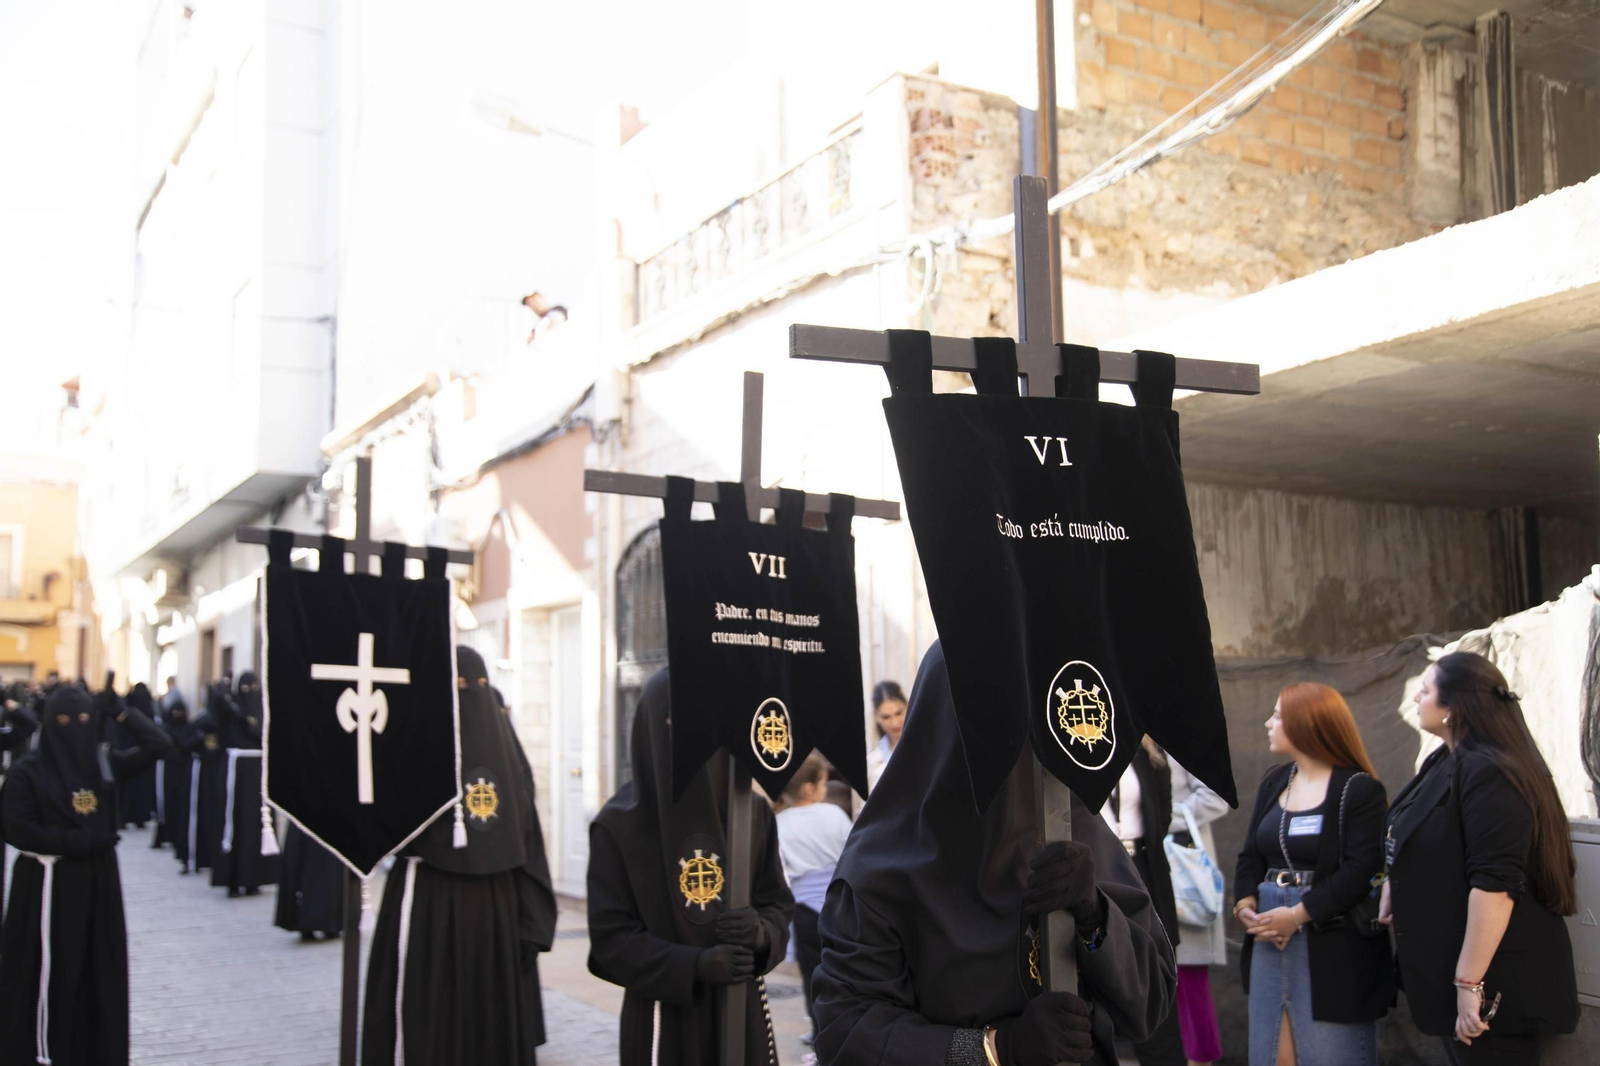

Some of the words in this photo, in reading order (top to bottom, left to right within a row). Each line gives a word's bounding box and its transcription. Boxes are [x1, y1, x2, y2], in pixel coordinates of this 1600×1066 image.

[1024, 436, 1073, 466] VI
[996, 513, 1024, 539] Todo
[1030, 512, 1064, 538] está
[1068, 520, 1130, 544] cumplido.
[748, 551, 787, 579] VII
[755, 607, 769, 620] en
[769, 608, 784, 623] tus
[785, 612, 820, 627] manos
[711, 630, 770, 647] encomiendo
